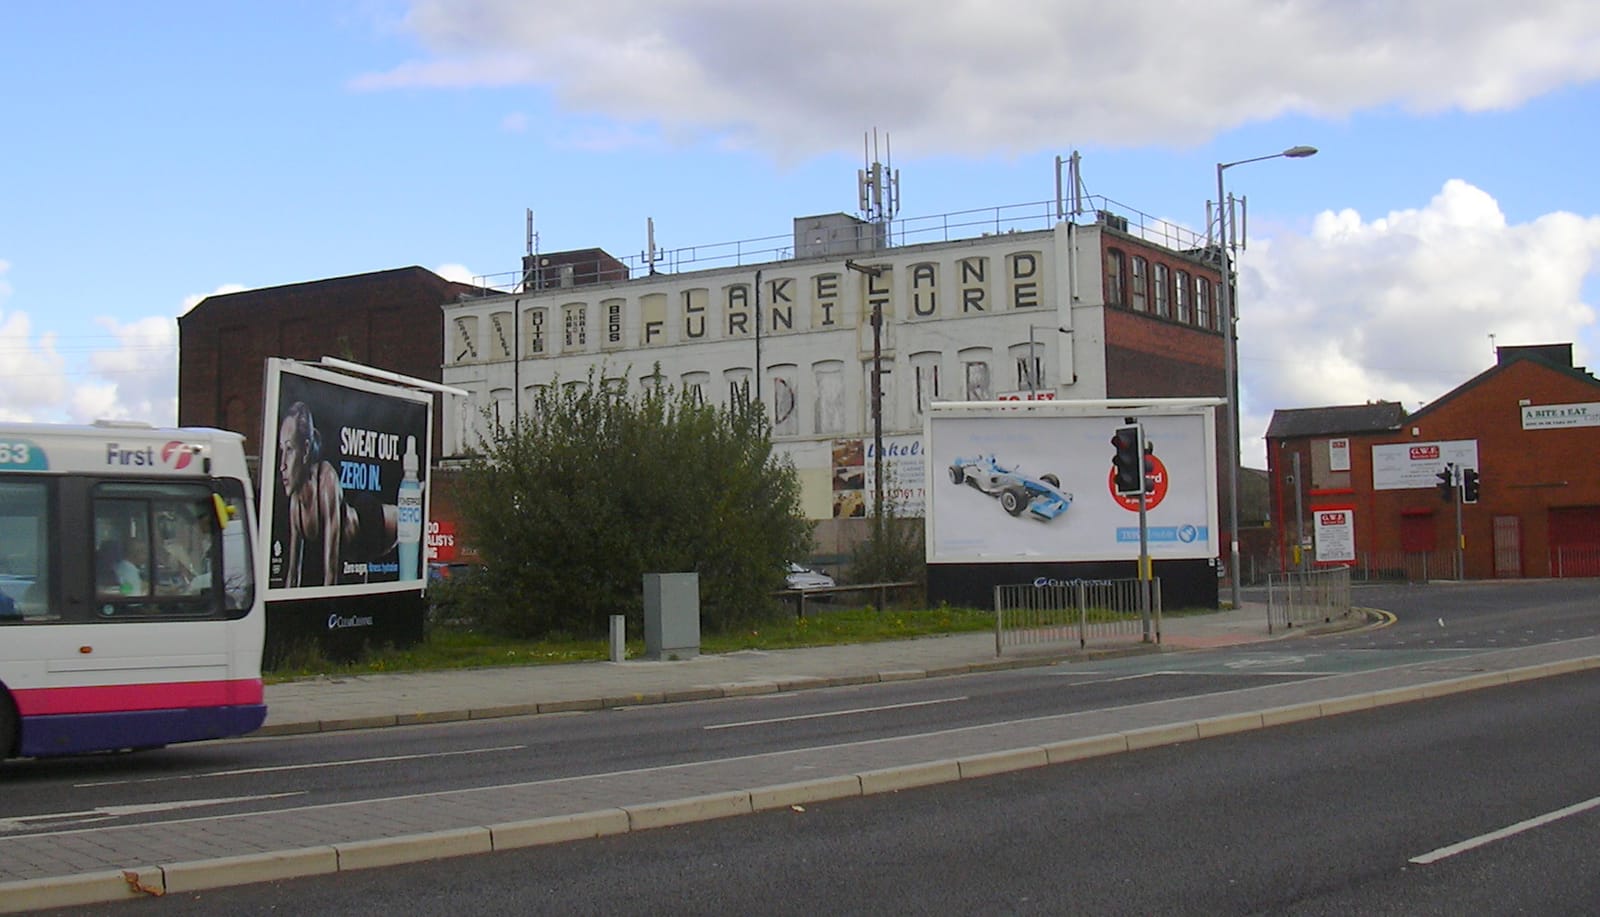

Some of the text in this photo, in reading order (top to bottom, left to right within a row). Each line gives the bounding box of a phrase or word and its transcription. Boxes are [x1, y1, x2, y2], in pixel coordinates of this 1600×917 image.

[686, 255, 1037, 313] LAKELAND
[609, 305, 620, 342] BEDS
[646, 282, 1037, 344] FURNITURE
[1526, 410, 1533, 418] A
[1535, 409, 1557, 417] BITE
[1567, 407, 1587, 416] EAT
[106, 443, 154, 466] First
[340, 426, 400, 461] SWEAT OUT.
[340, 461, 382, 491] ZERO IN.
